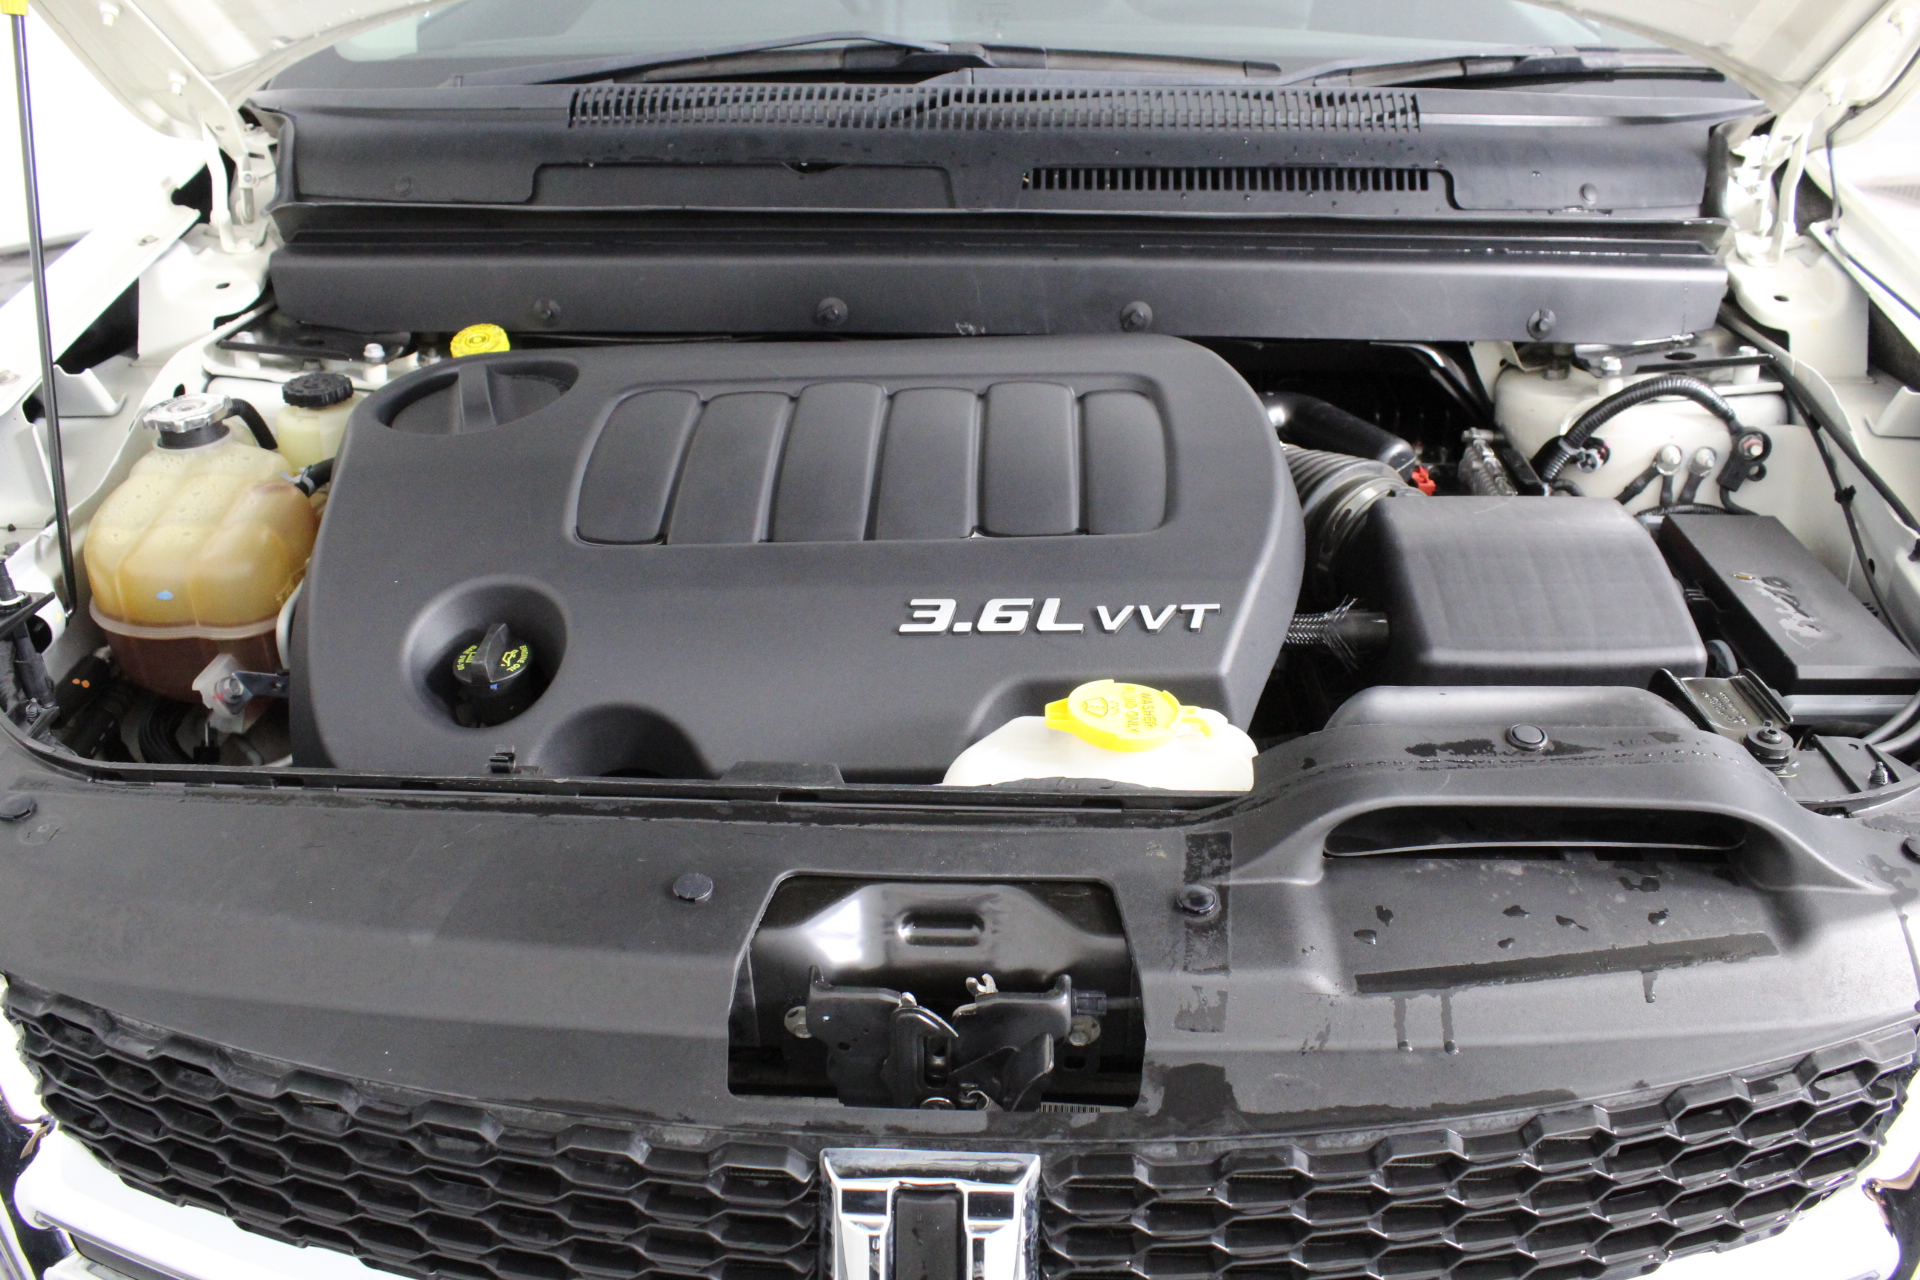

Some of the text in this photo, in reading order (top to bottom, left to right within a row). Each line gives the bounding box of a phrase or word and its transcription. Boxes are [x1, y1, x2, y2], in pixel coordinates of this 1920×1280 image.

[898, 597, 1221, 637] 3.6L VVT
[1121, 685, 1141, 733] FLUID ONLY
[1140, 692, 1157, 728] WASHER
